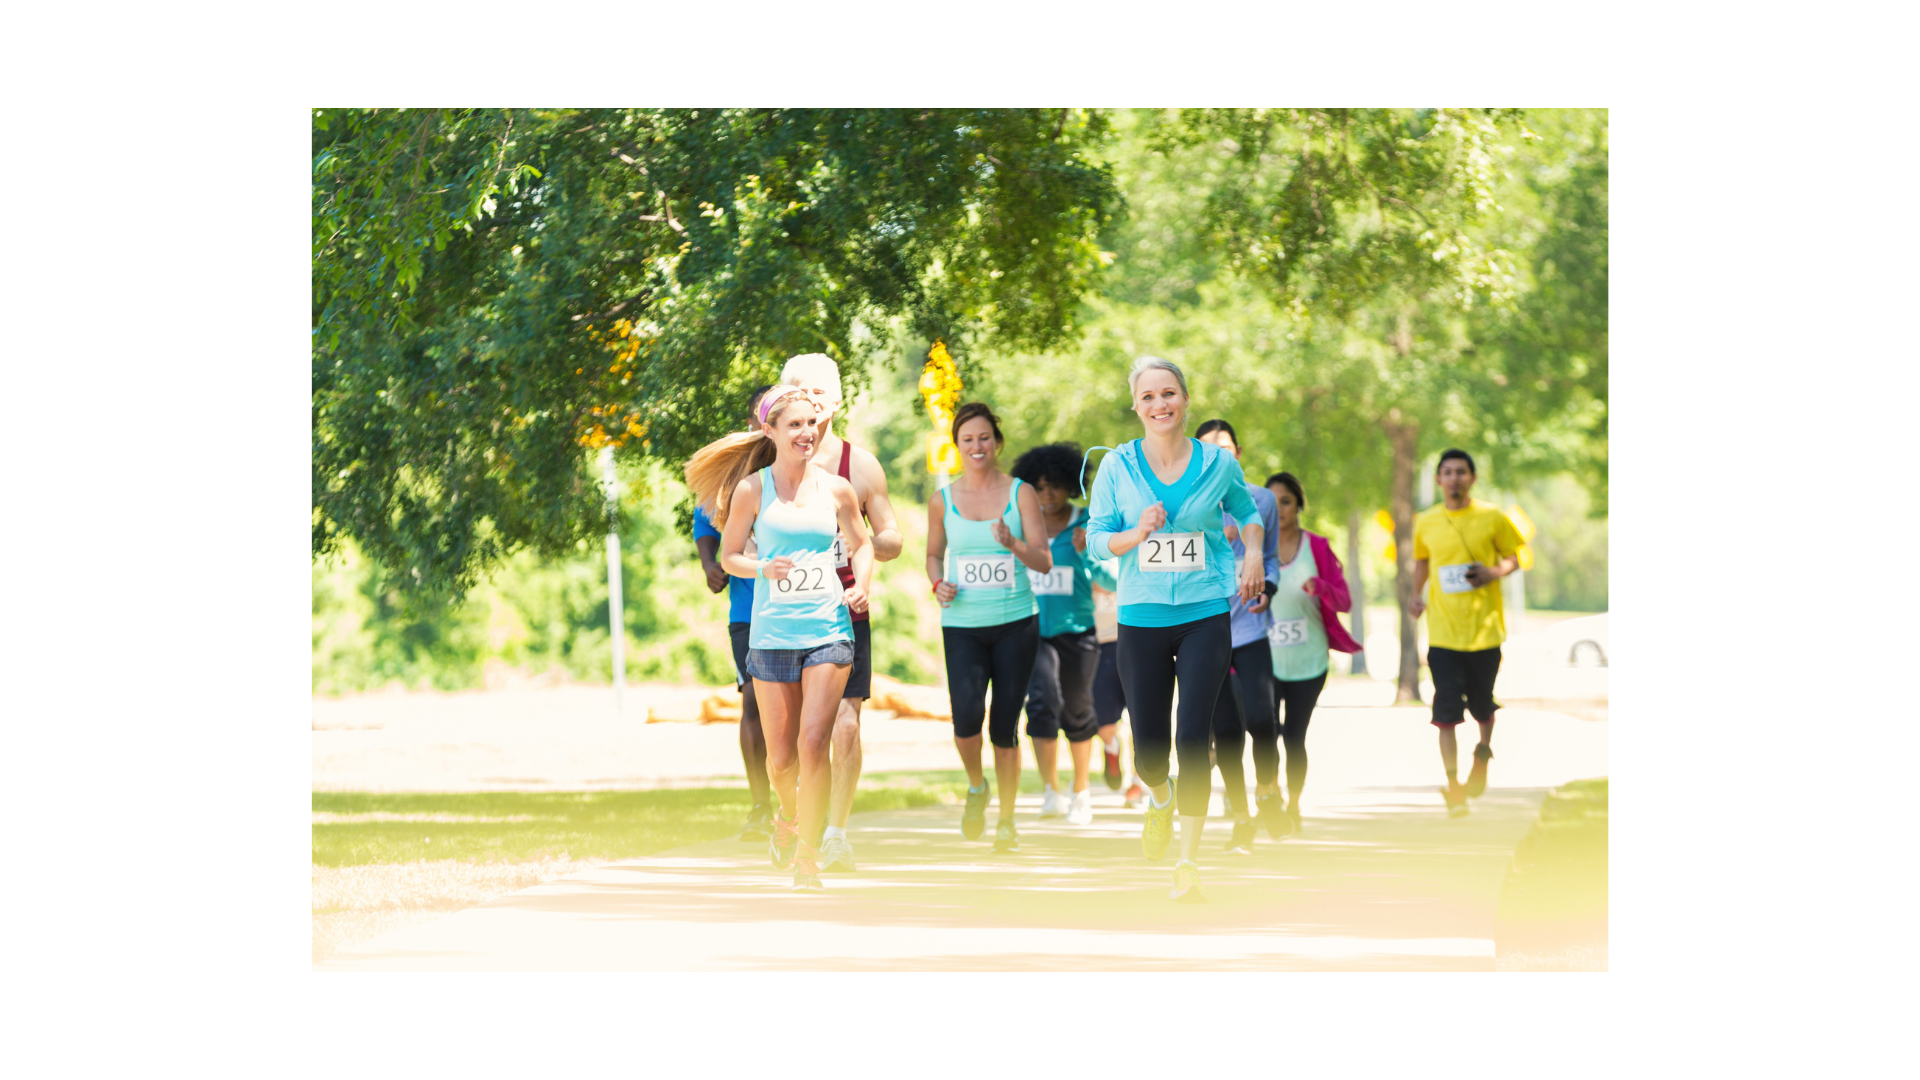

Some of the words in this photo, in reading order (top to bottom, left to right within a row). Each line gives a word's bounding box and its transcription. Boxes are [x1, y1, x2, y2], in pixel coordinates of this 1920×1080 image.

[1147, 539, 1197, 562] 214
[777, 567, 825, 593] 622
[965, 562, 1007, 583] 806
